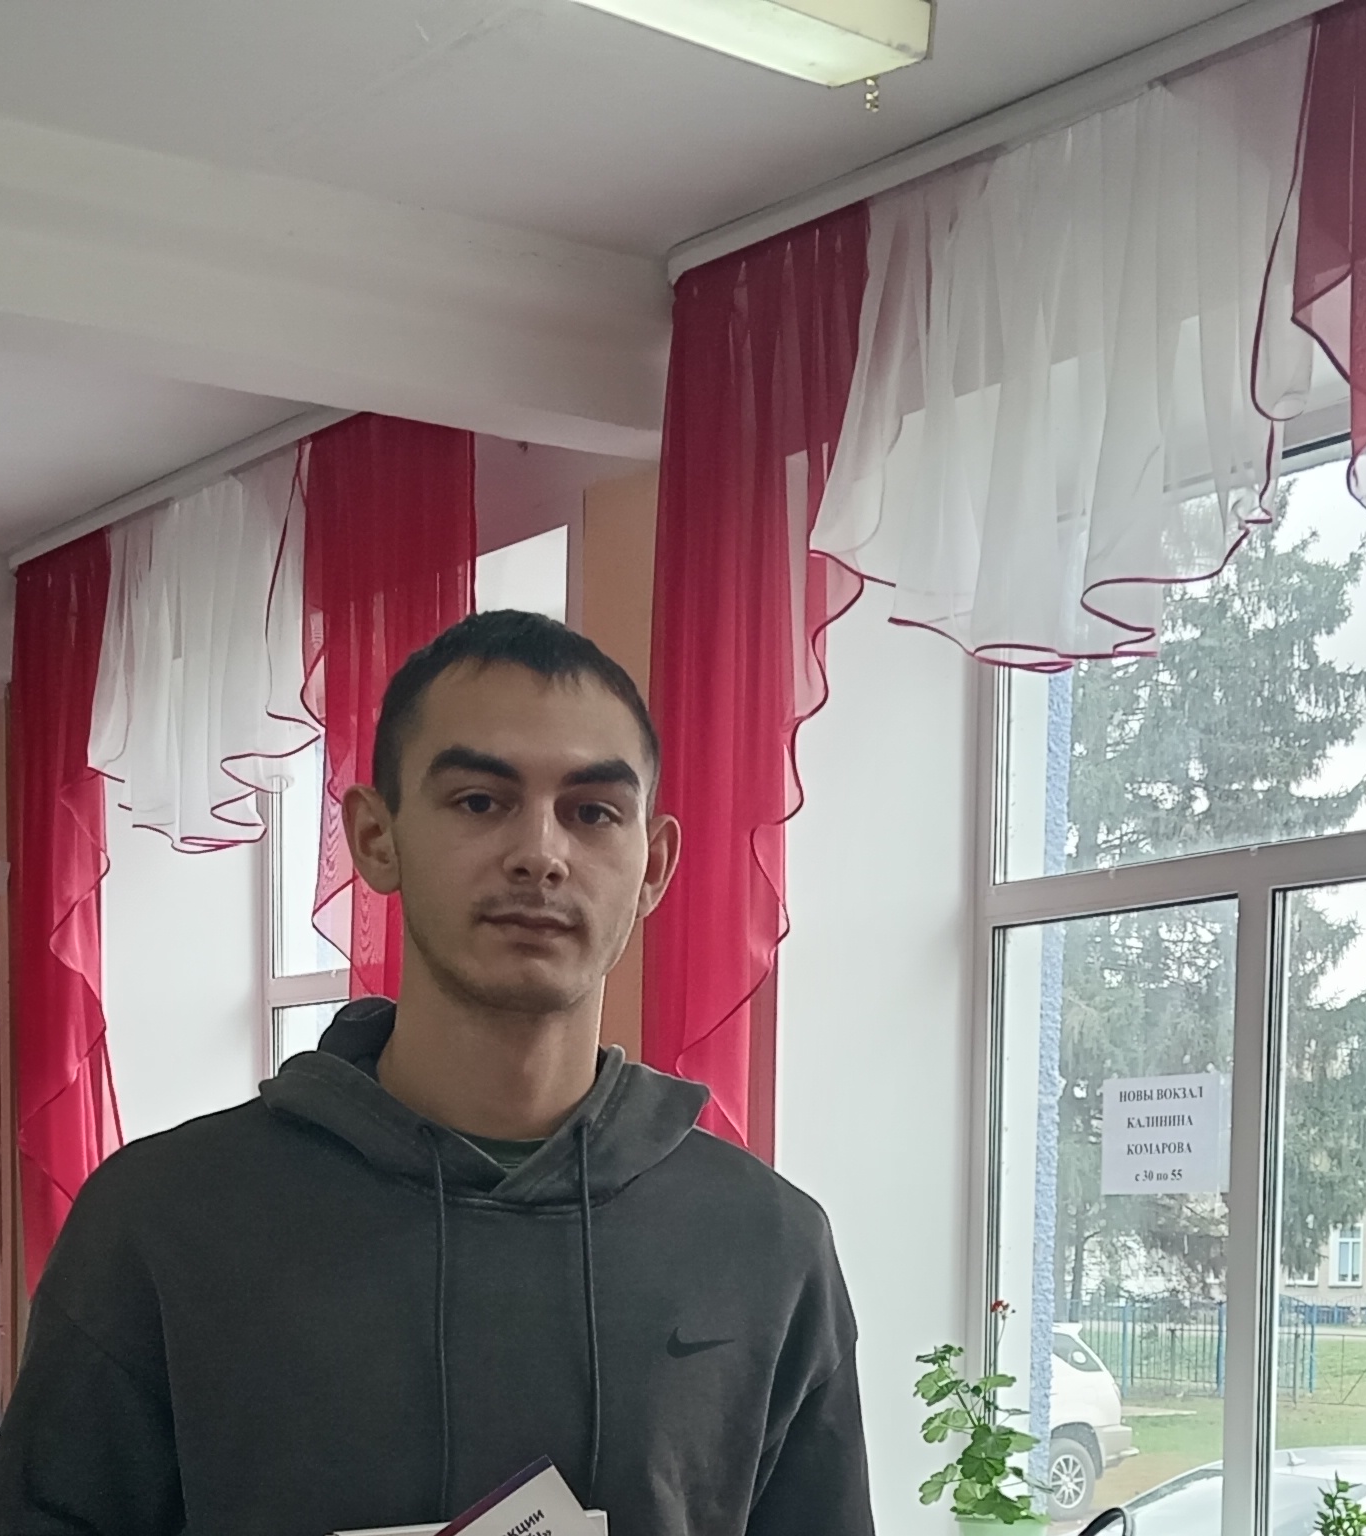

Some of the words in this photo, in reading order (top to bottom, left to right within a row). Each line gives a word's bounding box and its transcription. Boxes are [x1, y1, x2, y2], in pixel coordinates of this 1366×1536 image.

[1156, 1086, 1204, 1101] ВОКЗАЛ
[1126, 1114, 1194, 1130] КАЛИНИНА
[1126, 1142, 1192, 1156] КОМАРОВА
[1135, 1173, 1141, 1182] с
[1142, 1170, 1154, 1182] 30
[1156, 1172, 1168, 1181] по
[1171, 1169, 1183, 1181] 55
